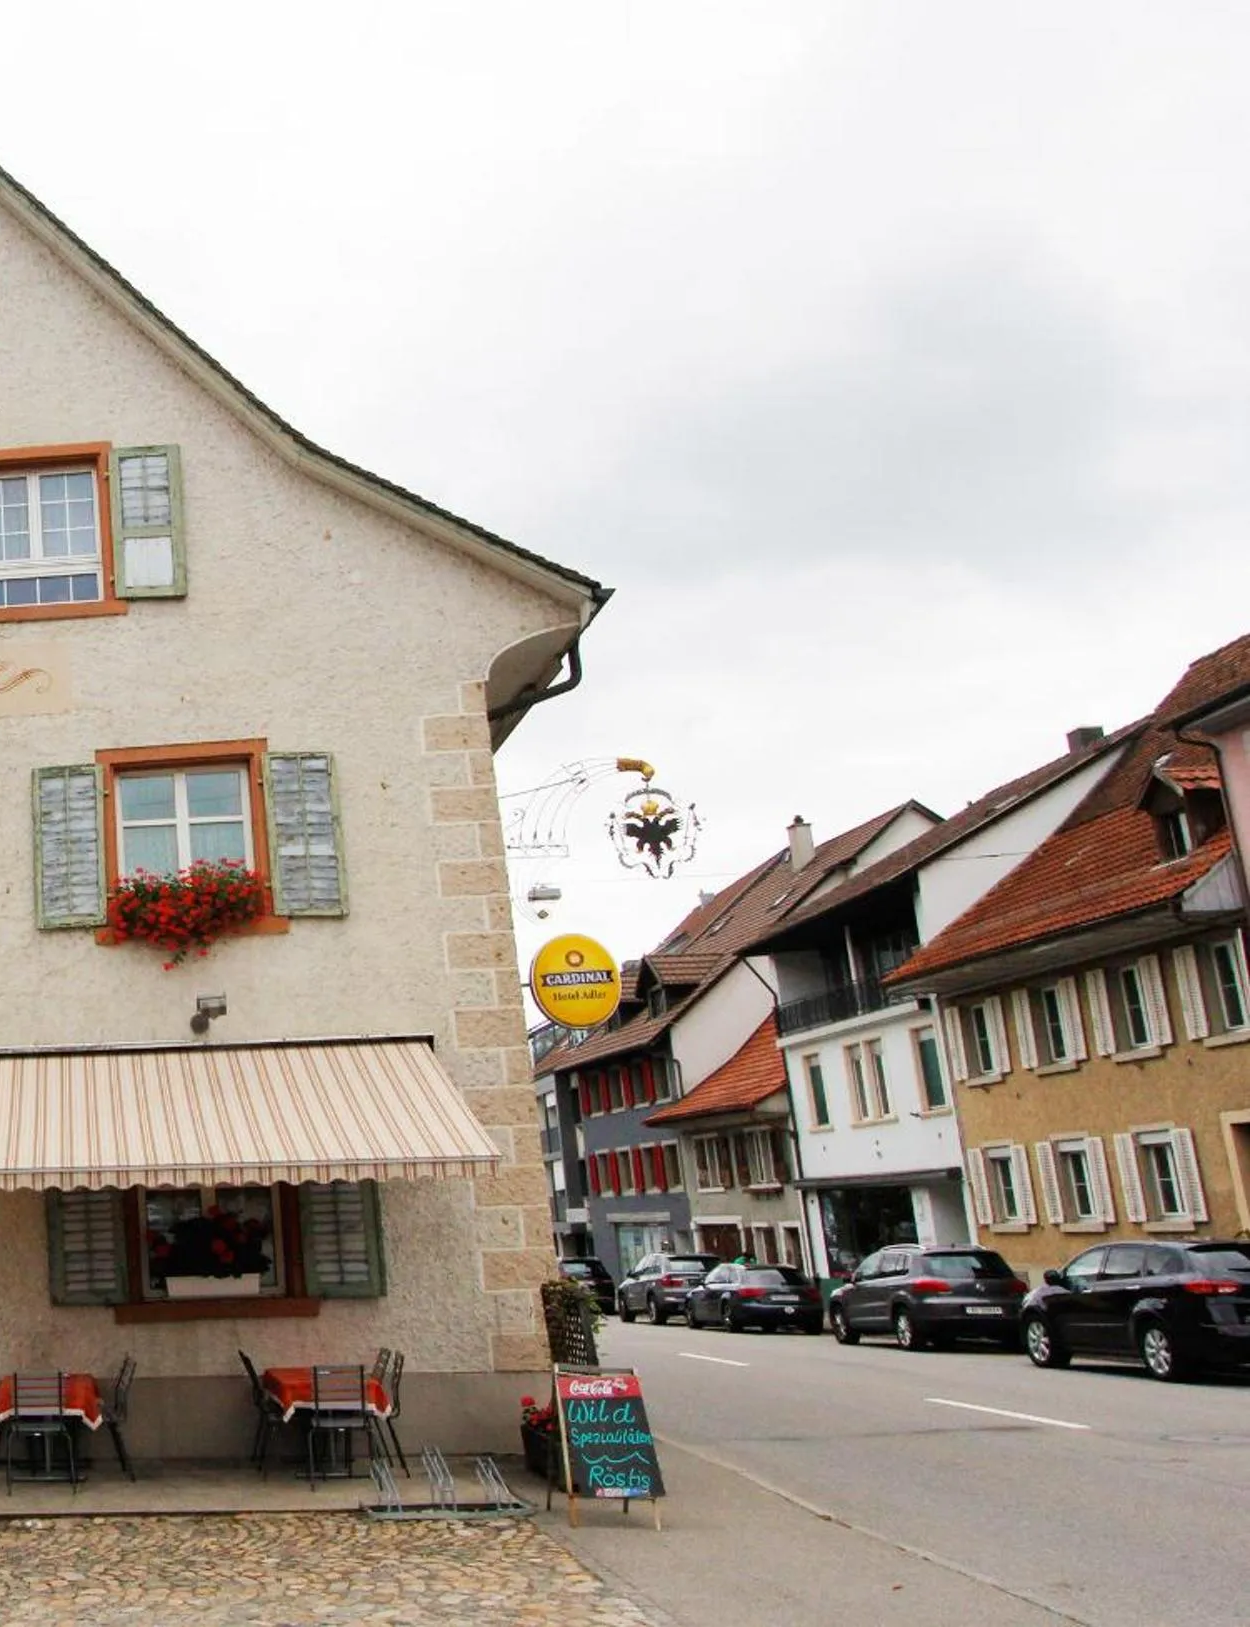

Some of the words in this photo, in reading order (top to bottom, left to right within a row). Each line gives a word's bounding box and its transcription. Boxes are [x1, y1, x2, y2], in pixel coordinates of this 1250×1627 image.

[546, 971, 611, 986] CARDINAL
[553, 991, 579, 1001] Hotel
[581, 989, 606, 1000] Adler
[567, 1400, 636, 1424] Wild
